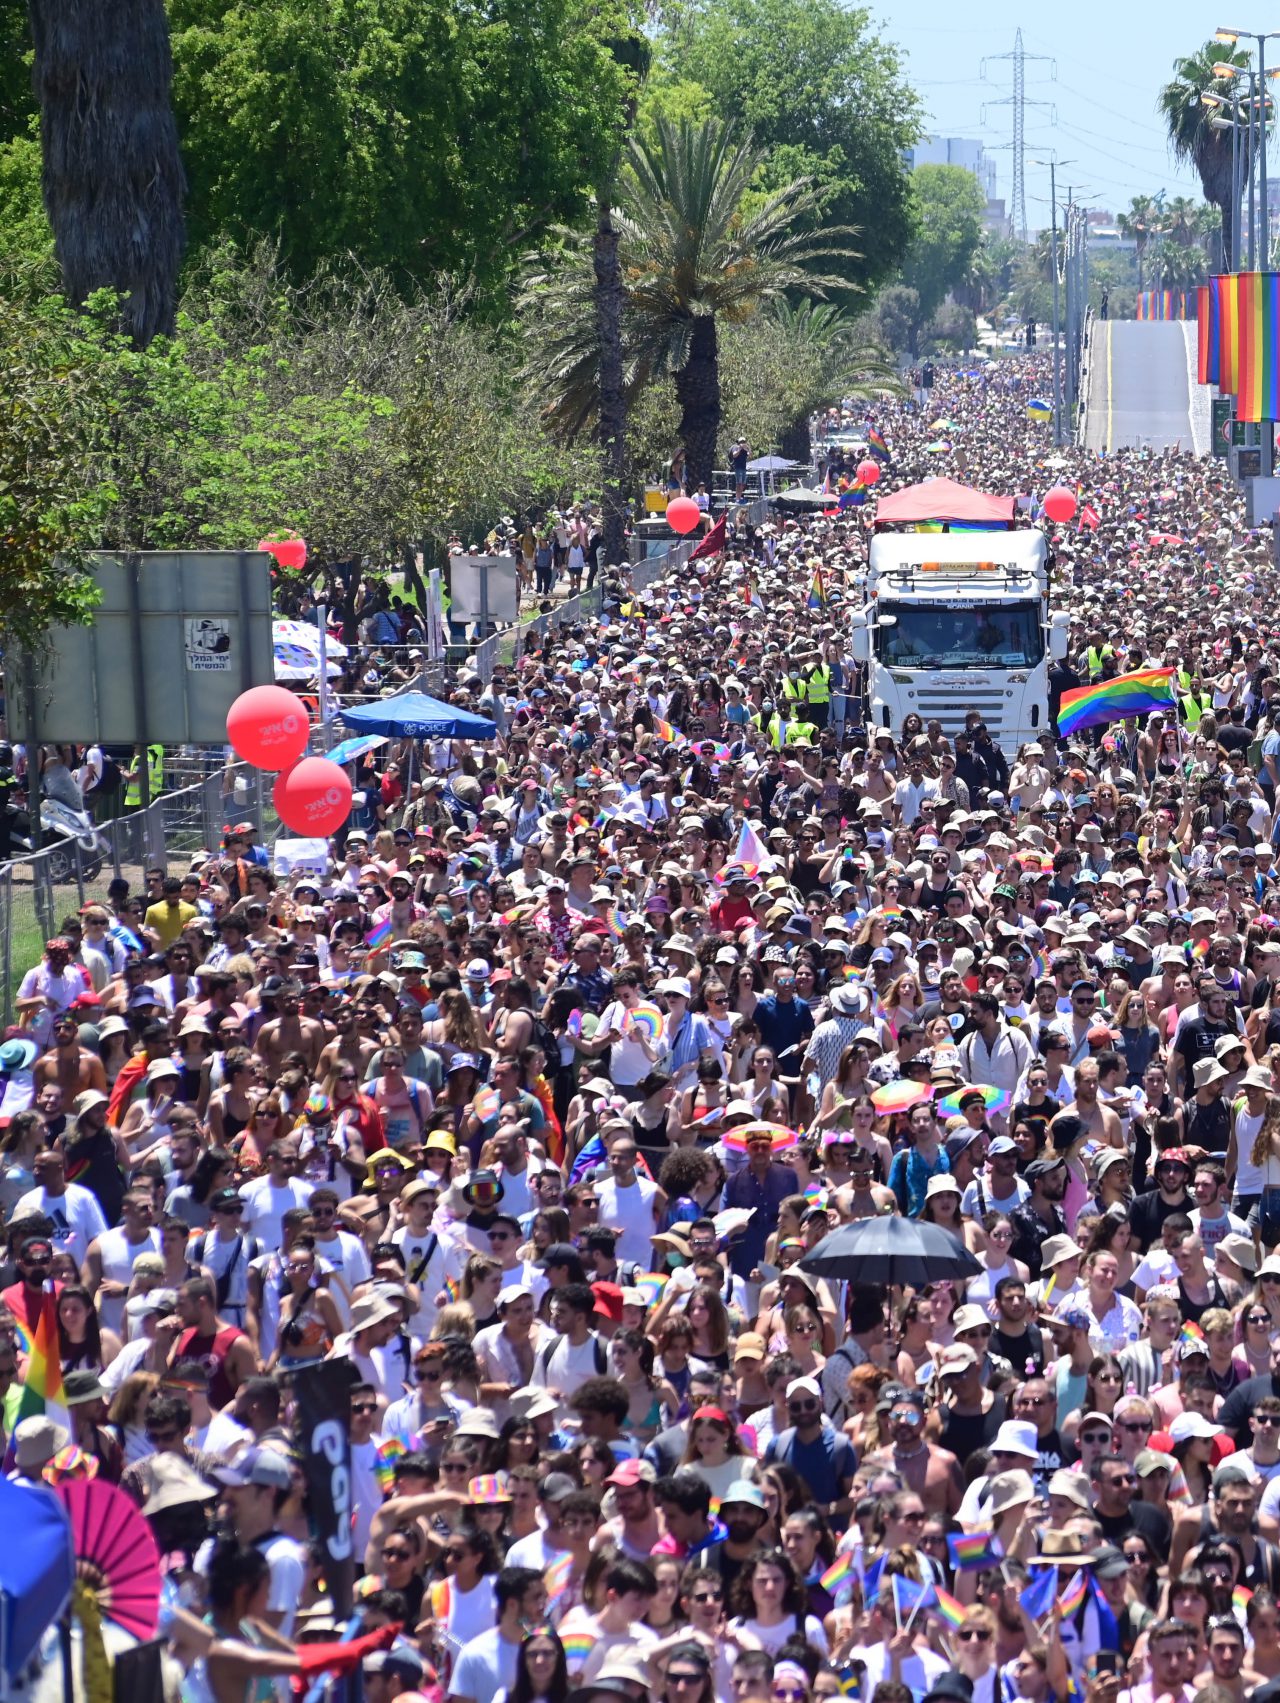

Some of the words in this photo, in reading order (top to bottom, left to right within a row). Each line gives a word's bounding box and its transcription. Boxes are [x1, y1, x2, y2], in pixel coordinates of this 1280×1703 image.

[189, 654, 212, 664] המלך
[928, 674, 992, 686] SCANIA
[419, 723, 447, 732] POLICE
